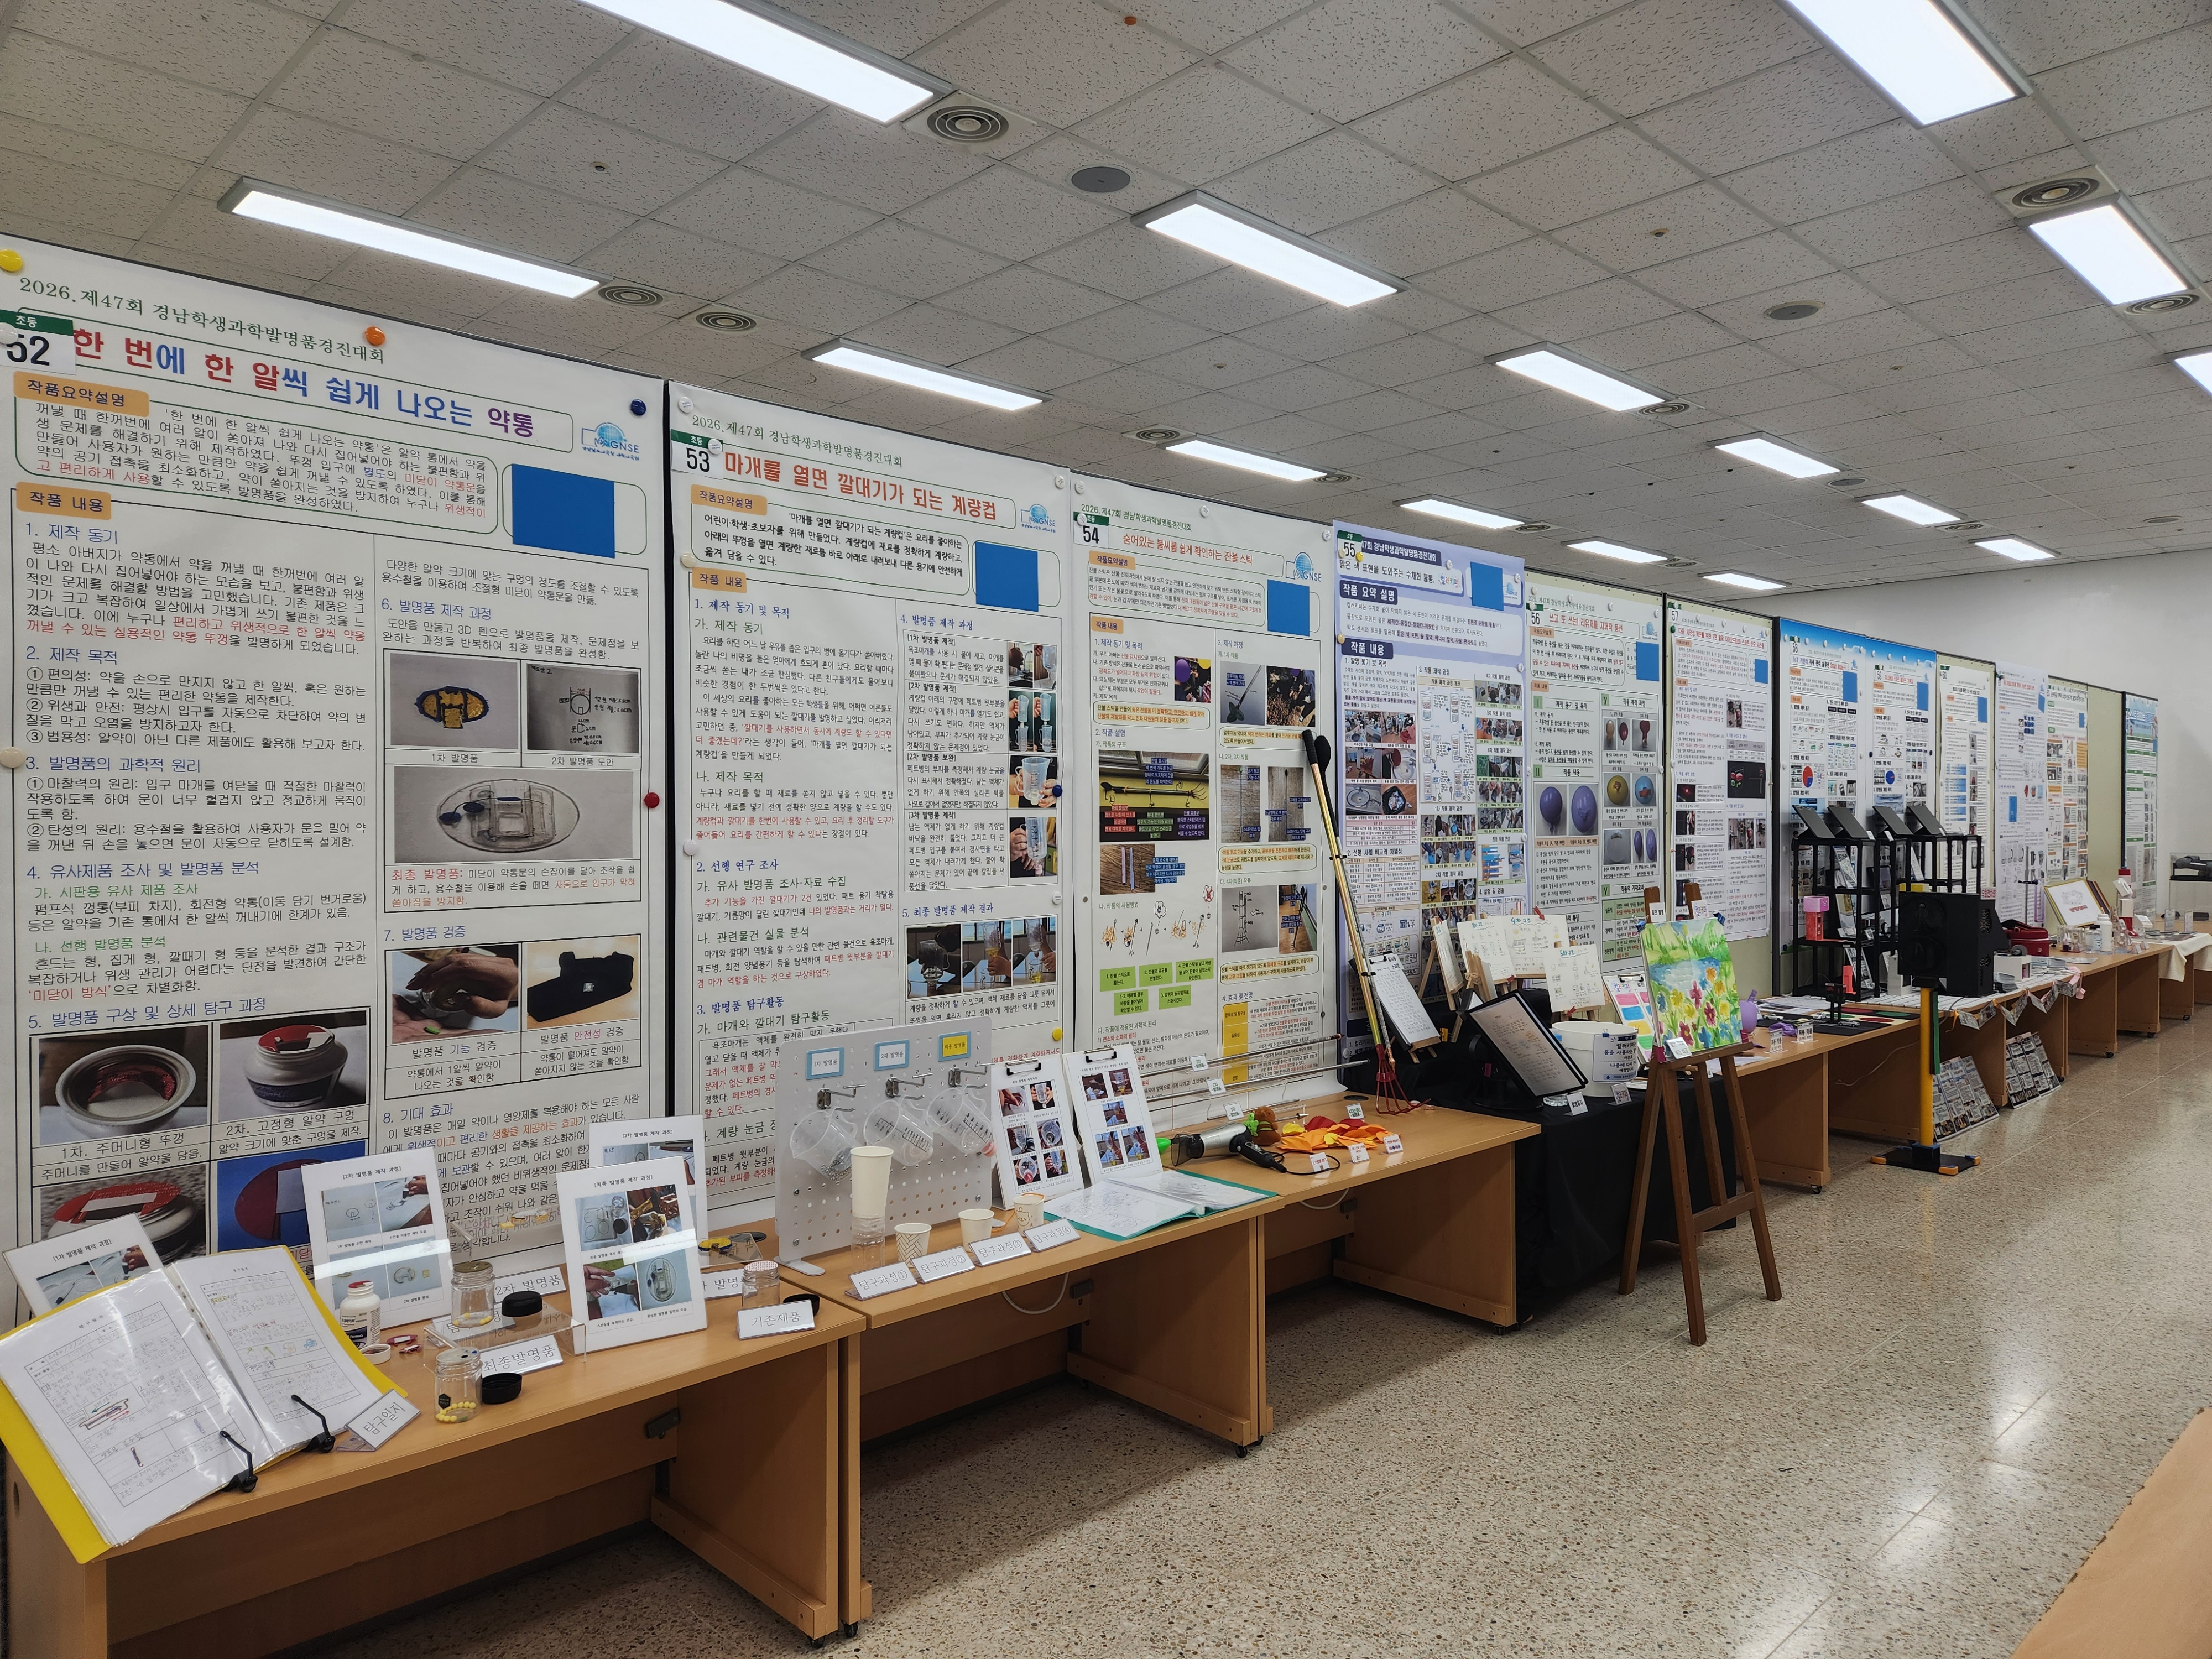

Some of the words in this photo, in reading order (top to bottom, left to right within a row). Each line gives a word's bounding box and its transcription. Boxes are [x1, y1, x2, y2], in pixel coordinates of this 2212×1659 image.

[15, 315, 37, 327] 초등
[153, 304, 384, 364] 경남학생과학발명품경진대회
[6, 335, 50, 366] 52
[74, 328, 105, 359] 한
[125, 338, 184, 374] 번에
[205, 354, 233, 383] 한
[253, 363, 307, 397] 알씩
[326, 377, 378, 410] 쉽게
[398, 390, 472, 426] 나오는
[488, 408, 533, 437] 약통
[28, 380, 124, 406] 작품요약설명
[609, 439, 639, 453] GNSE
[690, 436, 703, 445] 초등
[769, 431, 901, 467] 경남학생과학발명품경진대회
[686, 448, 709, 472] 53
[725, 452, 780, 482] 마개를
[794, 465, 827, 489] 열면
[838, 473, 904, 504] 깔대기가
[914, 488, 942, 510] 되는
[952, 495, 995, 520] 계량컵
[30, 492, 61, 507] 작품
[73, 497, 103, 512] 내용
[700, 491, 752, 509] 작품요약설명
[1039, 517, 1056, 528] GNSE
[1123, 512, 1191, 532] 경남학생과학발명품경진대회
[26, 523, 38, 536] 1.
[49, 524, 80, 540] 제작
[88, 529, 117, 544] 동기
[1083, 525, 1099, 544] 54
[705, 547, 722, 558] 옮겨
[728, 550, 742, 561] 담을
[747, 554, 754, 563] 수
[759, 555, 776, 566] 있다.
[1123, 534, 1154, 548] 숨어있는
[1157, 539, 1177, 552] 불씨를
[1180, 544, 1192, 555] 쉽게
[1194, 546, 1222, 560] 확인하는
[1224, 551, 1238, 563] 잔불
[1240, 555, 1253, 565] 스틱
[1344, 542, 1355, 557] 55
[1097, 555, 1128, 567] 작품요약설명
[1303, 570, 1321, 582] GNSE
[1340, 560, 1350, 570] 맑은
[1354, 562, 1359, 571] 색
[1363, 564, 1379, 574] 표현을
[1383, 567, 1403, 577] 도와주는
[1406, 571, 1421, 581] 수채화
[1343, 584, 1358, 596] 작품
[1363, 587, 1376, 598] 요약
[1380, 588, 1395, 601] 설명
[382, 598, 392, 610] 6.
[400, 600, 435, 614] 발명품
[441, 604, 463, 617] 제작
[469, 607, 491, 620] 과정
[696, 599, 702, 608] 1.
[709, 599, 730, 612] 제작
[735, 602, 753, 614] 동기
[759, 605, 766, 616] 및
[772, 607, 789, 619] 목적
[1532, 612, 1540, 624] 56
[1672, 611, 1678, 621] 57
[1550, 614, 1558, 623] 쓰고
[1581, 618, 1598, 629] 리유저블
[1615, 624, 1623, 633] 풍선
[922, 635, 939, 644] 발명품
[1350, 641, 1366, 654] 작품
[1370, 644, 1384, 656] 내용
[1792, 643, 1798, 653] 58
[1877, 671, 1881, 680] 59
[48, 731, 90, 743] 범용성:
[99, 733, 135, 744] 알약이
[145, 734, 168, 745] 아닌
[176, 735, 200, 746] 다른
[207, 736, 255, 747] 제품에도
[262, 738, 295, 749] 활용해
[302, 739, 335, 750] 보고자
[341, 740, 364, 750] 한다.
[432, 753, 446, 762] 1차
[451, 753, 478, 763] 발명품
[27, 866, 40, 879] 4.
[50, 864, 112, 879] 유사제품
[121, 864, 150, 877] 조사
[159, 863, 172, 877] 및
[181, 862, 224, 875] 발명품
[232, 862, 258, 874] 분석
[697, 1005, 705, 1014] 3.
[712, 1000, 741, 1013] 발명품
[747, 997, 784, 1010] 탐구활동
[1228, 993, 1238, 1001] 효과
[823, 1057, 838, 1065] 발명품
[383, 1113, 393, 1123] 8.
[401, 1107, 424, 1120] 기대
[430, 1103, 453, 1117] 효과
[1033, 1226, 1071, 1243] 탐구과정④
[979, 1240, 1022, 1257] 탐구과정③
[921, 1255, 966, 1274] 탐구과정②
[523, 1275, 560, 1288] 발명품
[859, 1270, 907, 1290] 탐구과정①
[752, 1312, 800, 1327] 기존제품
[484, 1345, 555, 1372] 최종발명품
[363, 1402, 405, 1434] 탐구일지
